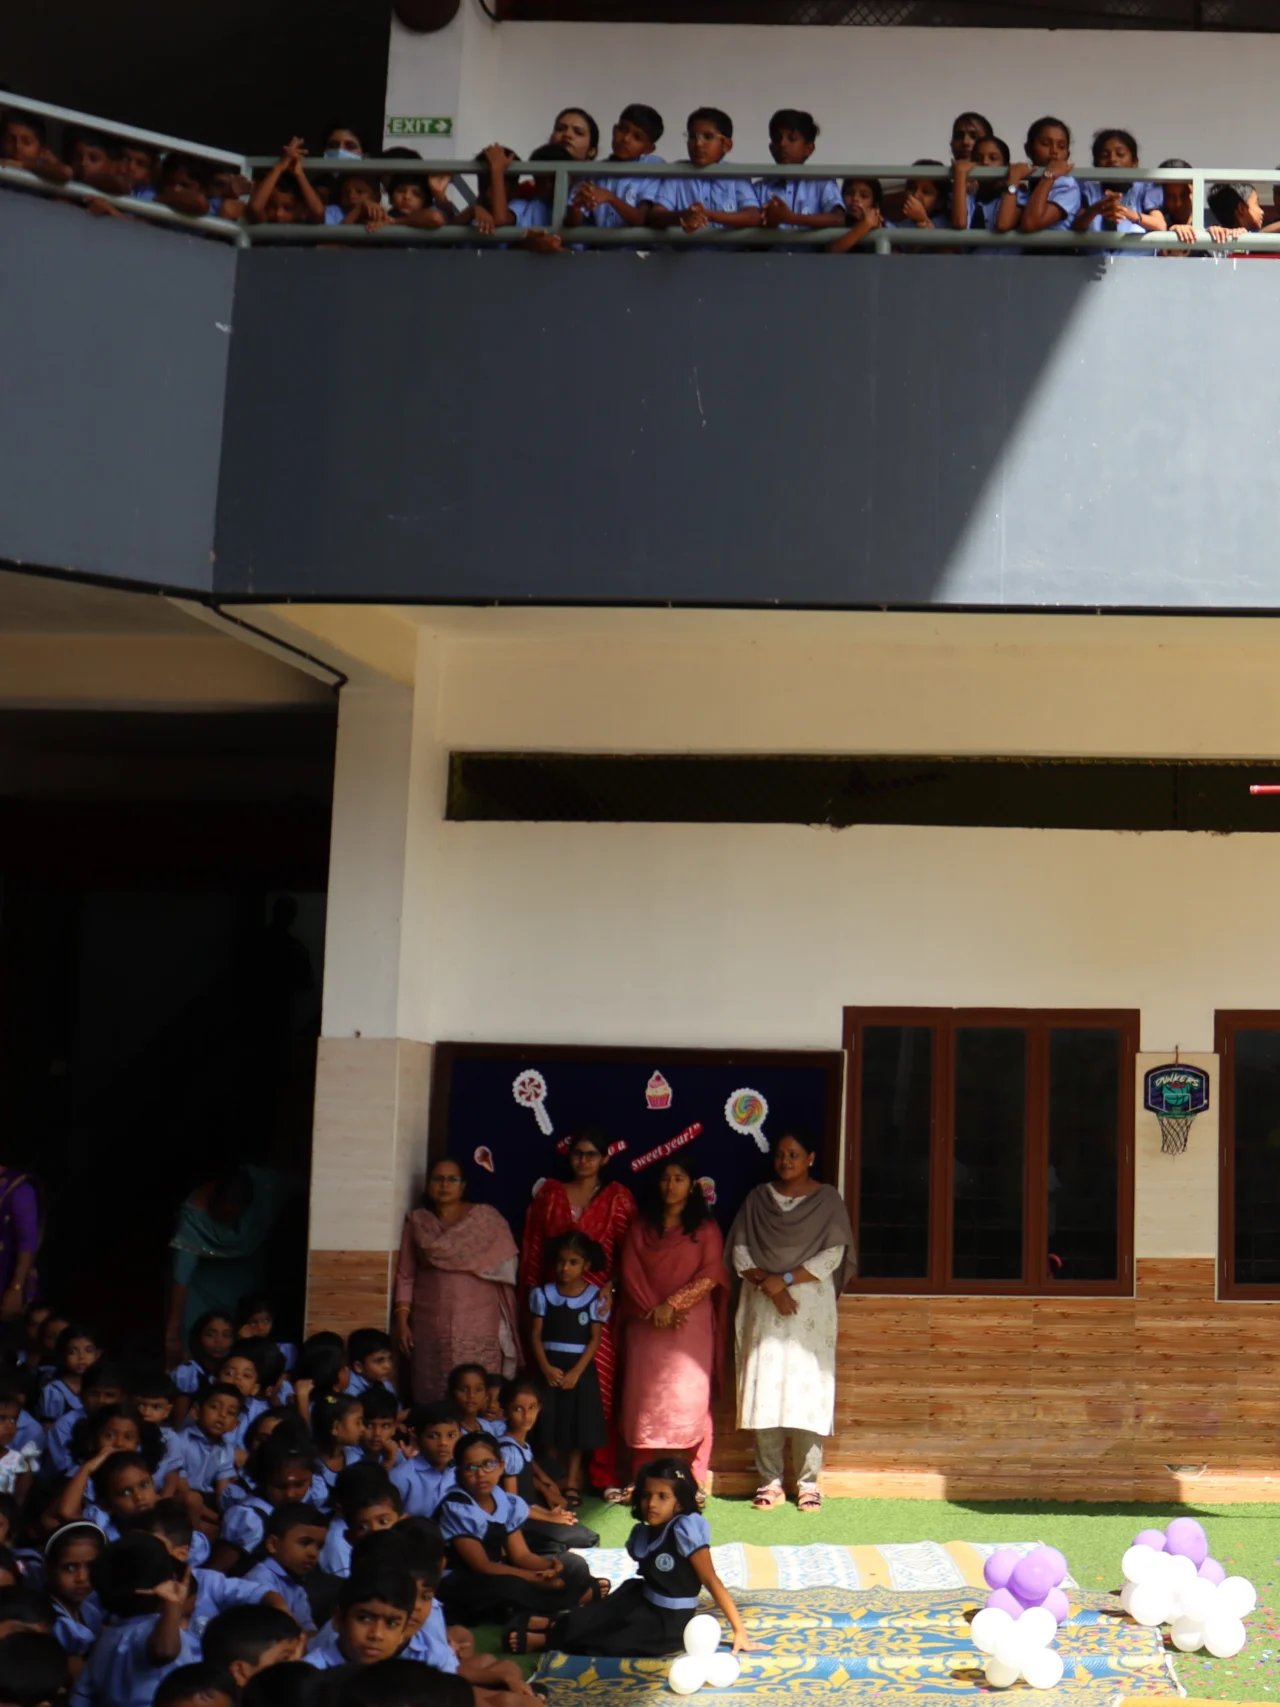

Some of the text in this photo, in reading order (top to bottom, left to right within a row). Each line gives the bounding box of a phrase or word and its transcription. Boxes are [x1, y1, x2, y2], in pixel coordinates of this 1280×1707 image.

[391, 119, 433, 134] EXIT
[617, 1140, 627, 1151] a
[630, 1145, 663, 1170] sweet
